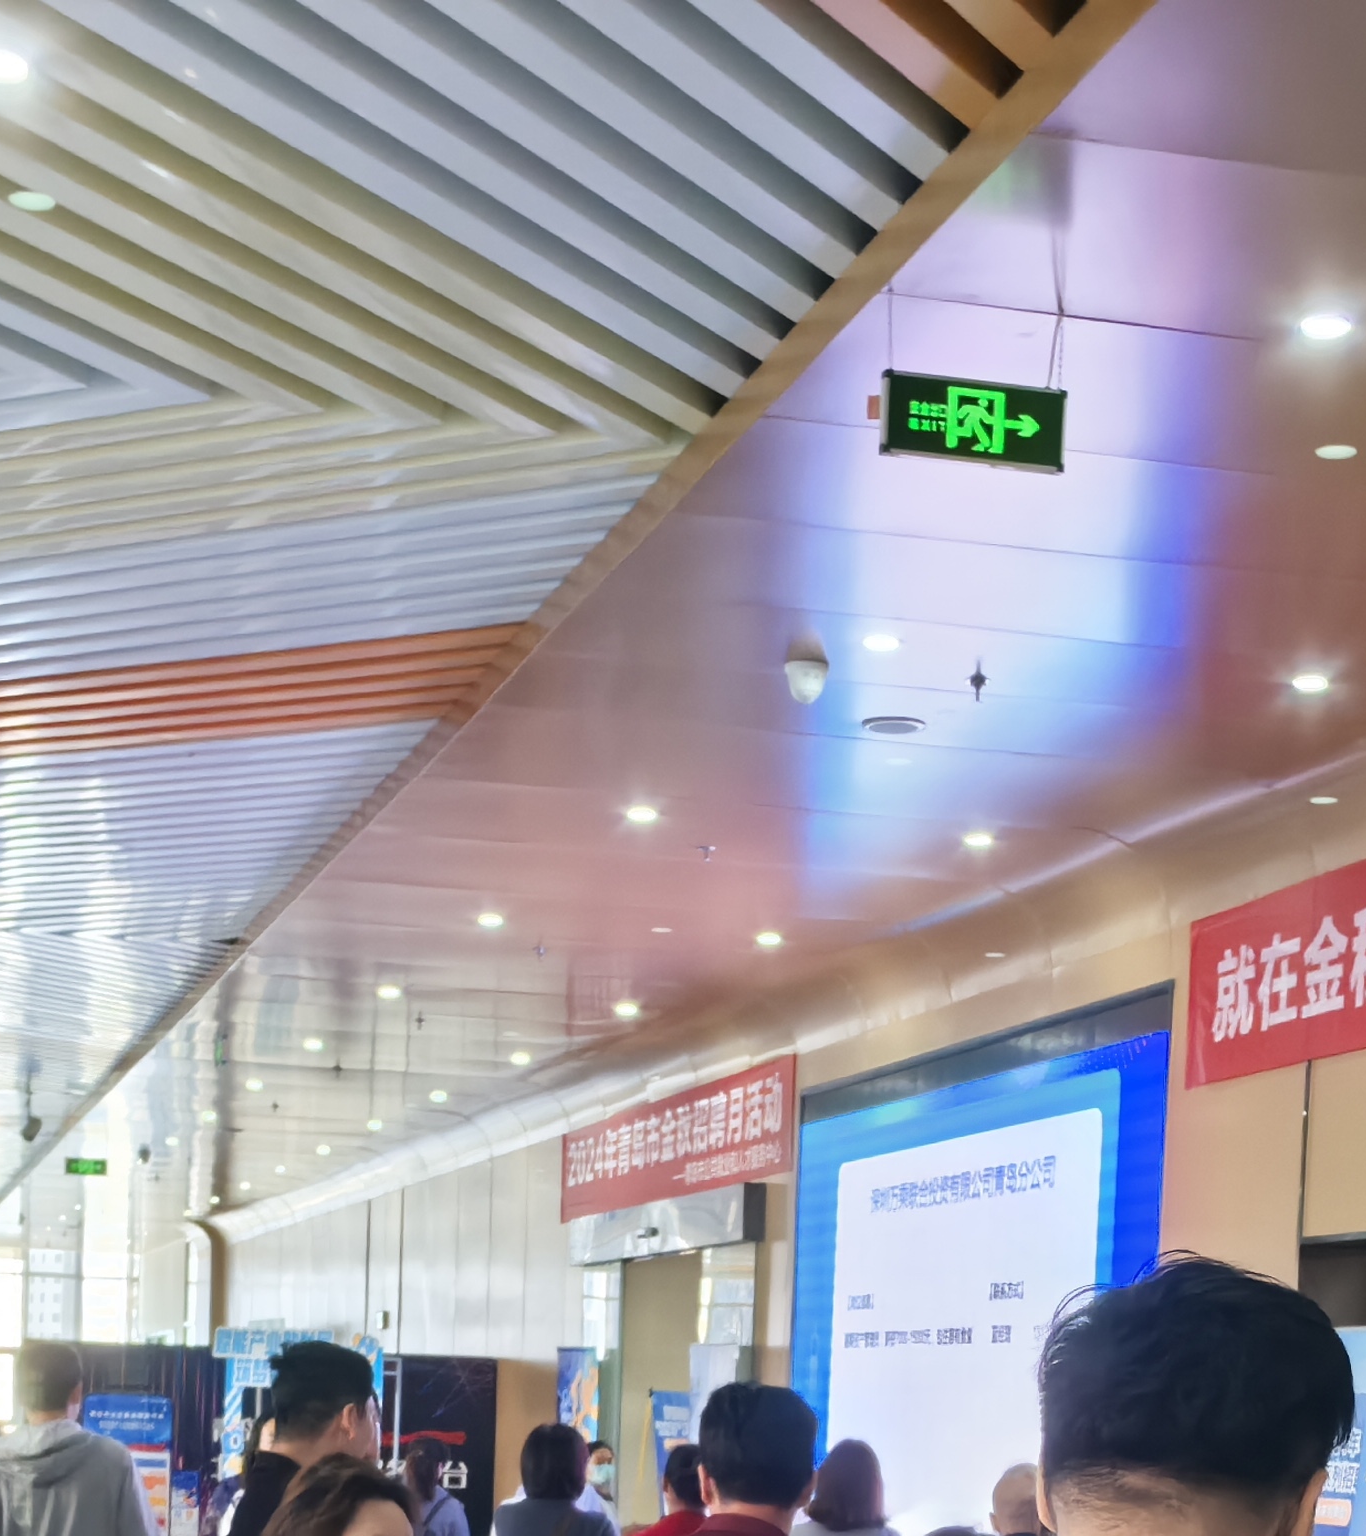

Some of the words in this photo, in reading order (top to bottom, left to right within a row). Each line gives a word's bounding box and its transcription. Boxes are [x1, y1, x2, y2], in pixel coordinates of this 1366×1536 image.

[566, 1072, 784, 1188] 2024年青岛市金秋招聘月活动
